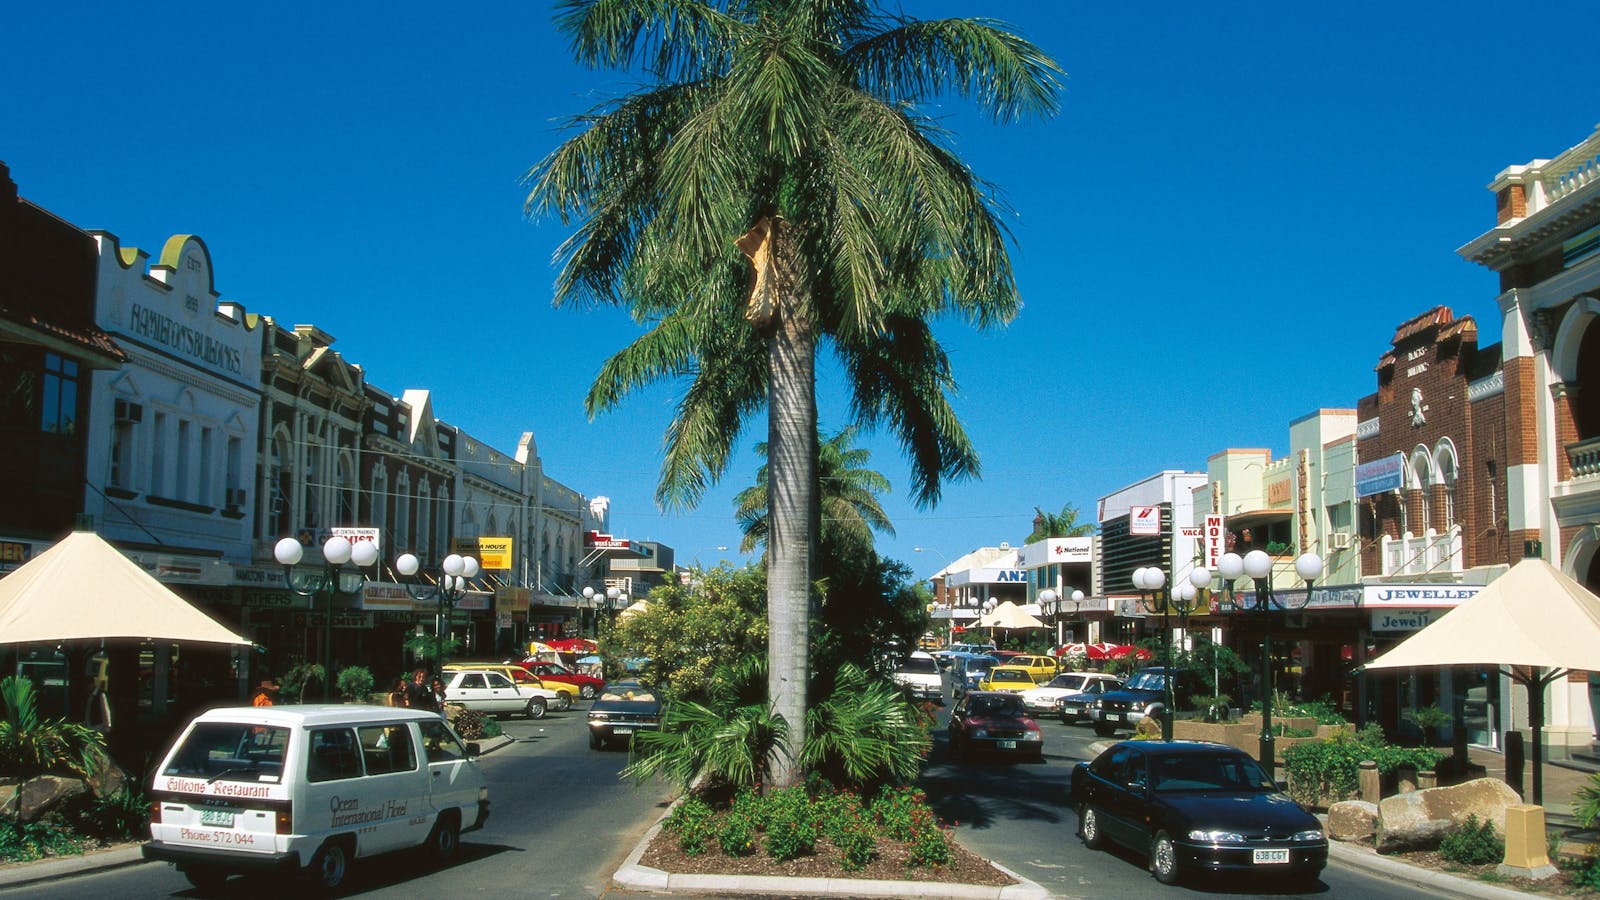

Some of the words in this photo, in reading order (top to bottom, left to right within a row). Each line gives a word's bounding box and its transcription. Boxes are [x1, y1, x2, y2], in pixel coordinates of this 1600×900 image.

[1064, 546, 1090, 554] National
[1207, 517, 1221, 567] MOTEL
[1382, 615, 1430, 628] Jewell
[213, 780, 271, 798] Restaurant
[330, 795, 359, 812] Ocean
[331, 803, 385, 828] International
[180, 828, 211, 842] Phone
[213, 831, 232, 843] 572
[234, 833, 254, 845] 044
[1256, 851, 1269, 860] 638
